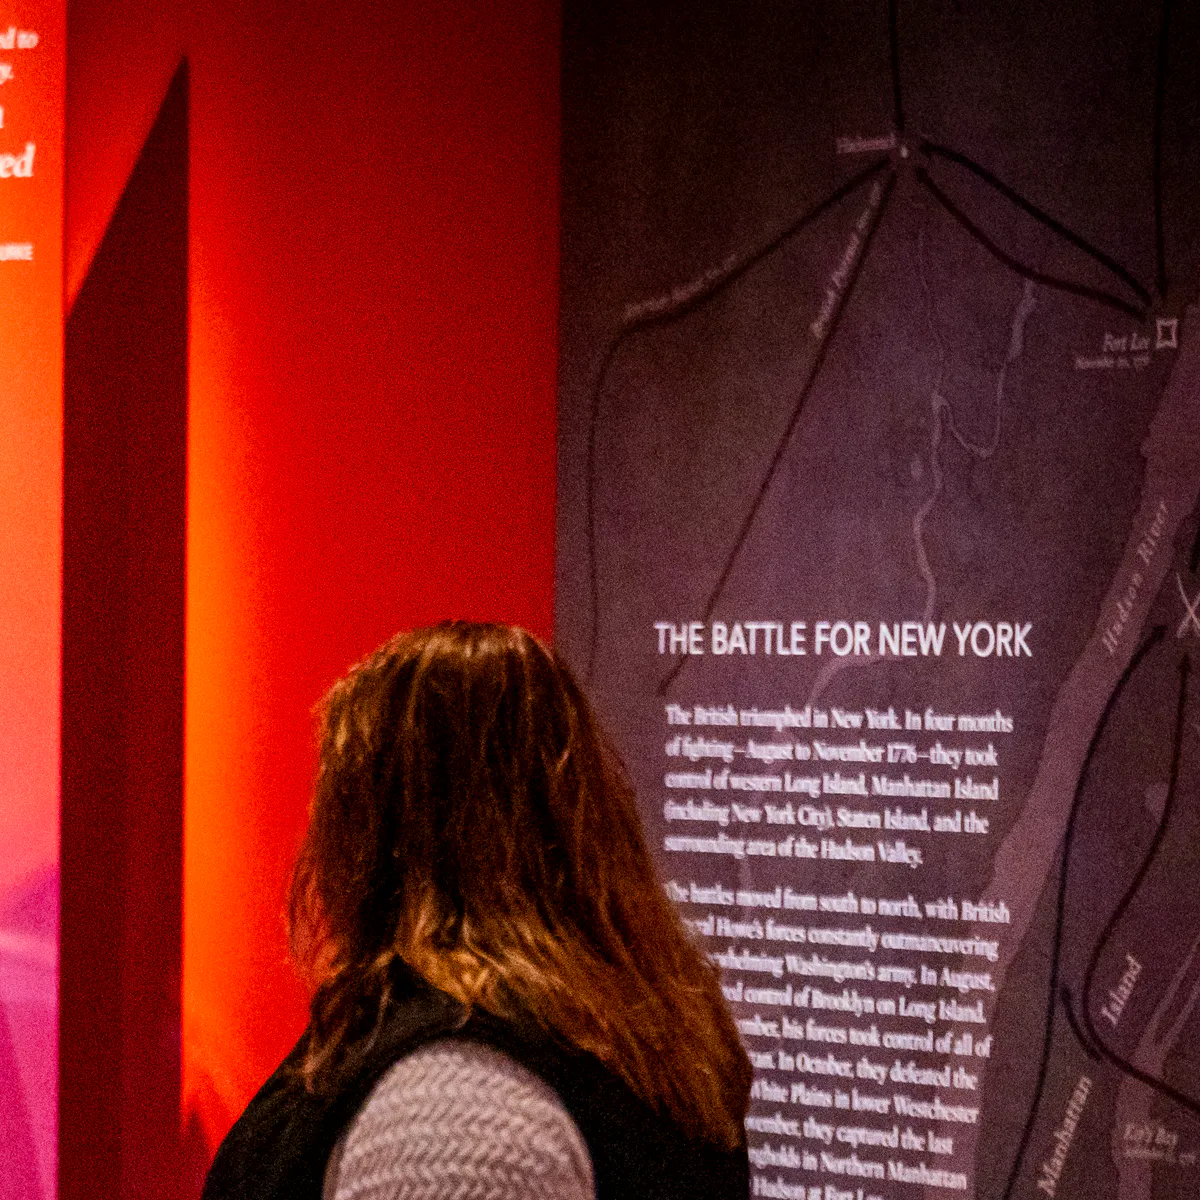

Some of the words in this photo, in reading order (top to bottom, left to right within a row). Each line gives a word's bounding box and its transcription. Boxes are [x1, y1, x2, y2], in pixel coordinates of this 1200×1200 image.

[1101, 572, 1144, 656] Hudson
[1137, 497, 1168, 567] River
[653, 620, 705, 657] THE
[711, 620, 807, 657] BATTLE
[814, 620, 871, 658] FOR
[878, 620, 946, 658] NEW
[952, 621, 1034, 659] YORK
[1101, 952, 1142, 1028] Island
[1036, 1075, 1093, 1198] Manhattan
